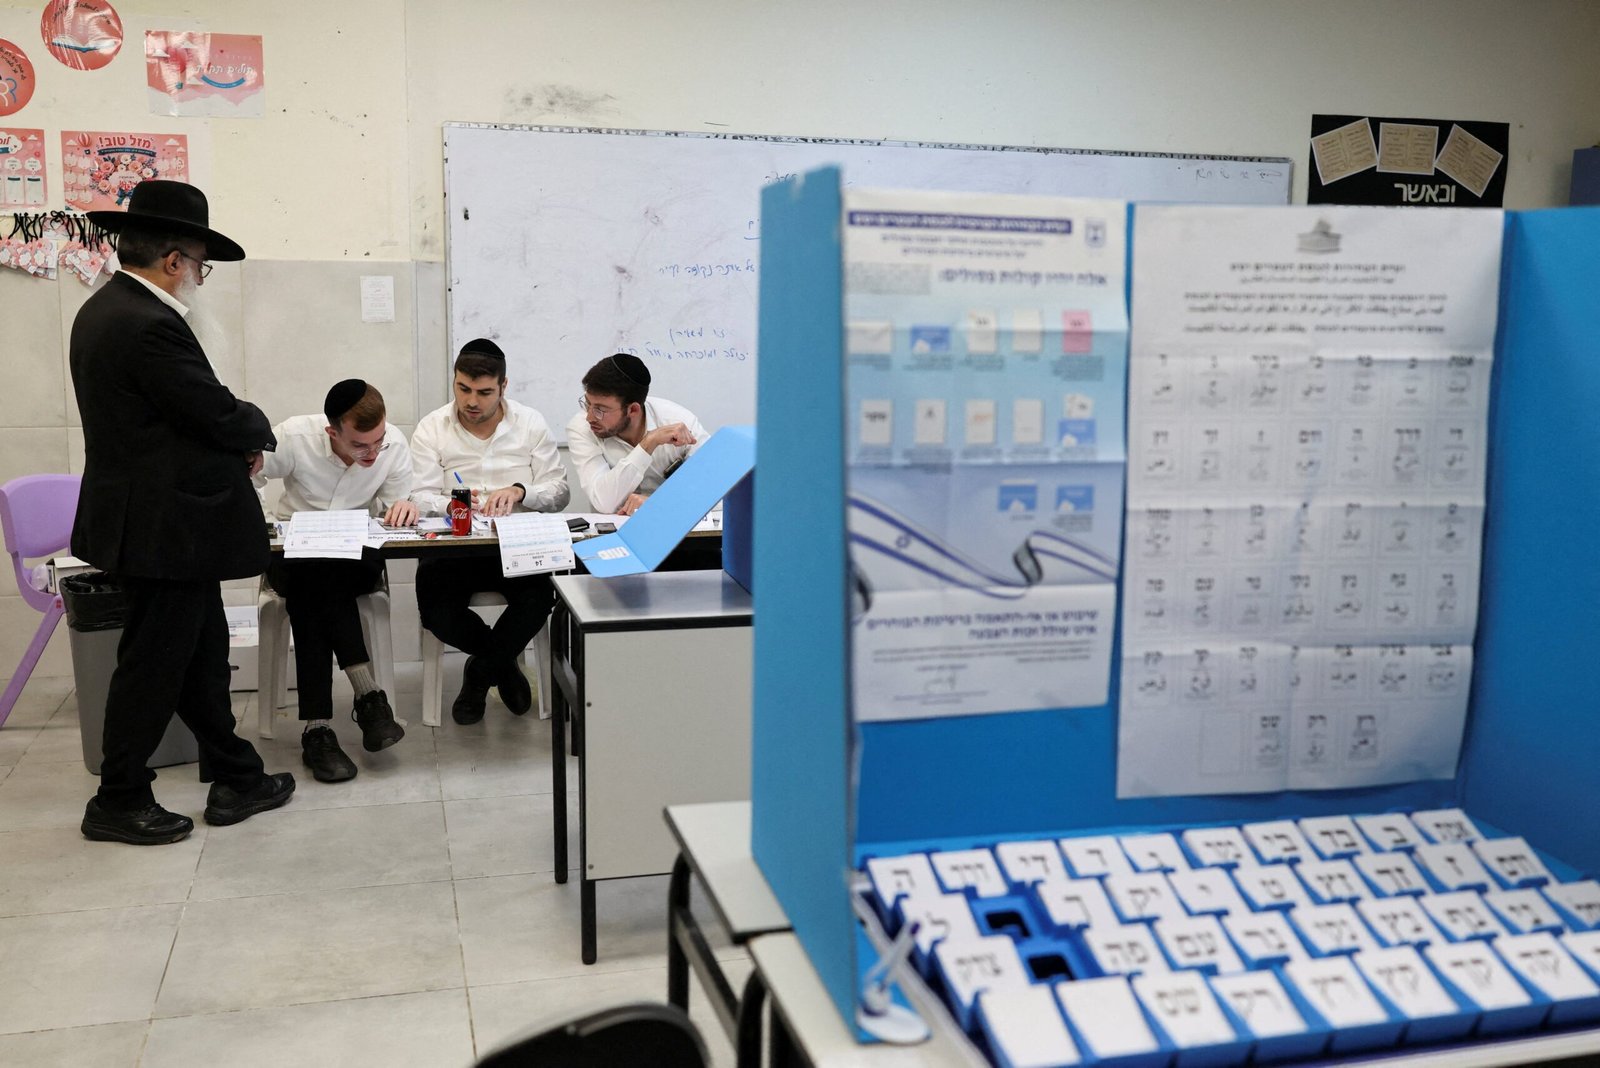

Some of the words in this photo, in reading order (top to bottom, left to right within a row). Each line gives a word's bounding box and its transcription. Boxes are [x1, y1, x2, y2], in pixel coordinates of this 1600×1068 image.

[98, 135, 126, 148] טוב!
[130, 134, 151, 149] מזל
[1394, 182, 1456, 203] וכאשר
[1262, 834, 1298, 852] בי
[1382, 826, 1407, 843] ב
[1260, 879, 1285, 899] ט
[1104, 941, 1149, 965] פה
[1176, 930, 1216, 957] עם
[1156, 988, 1199, 1015] שס
